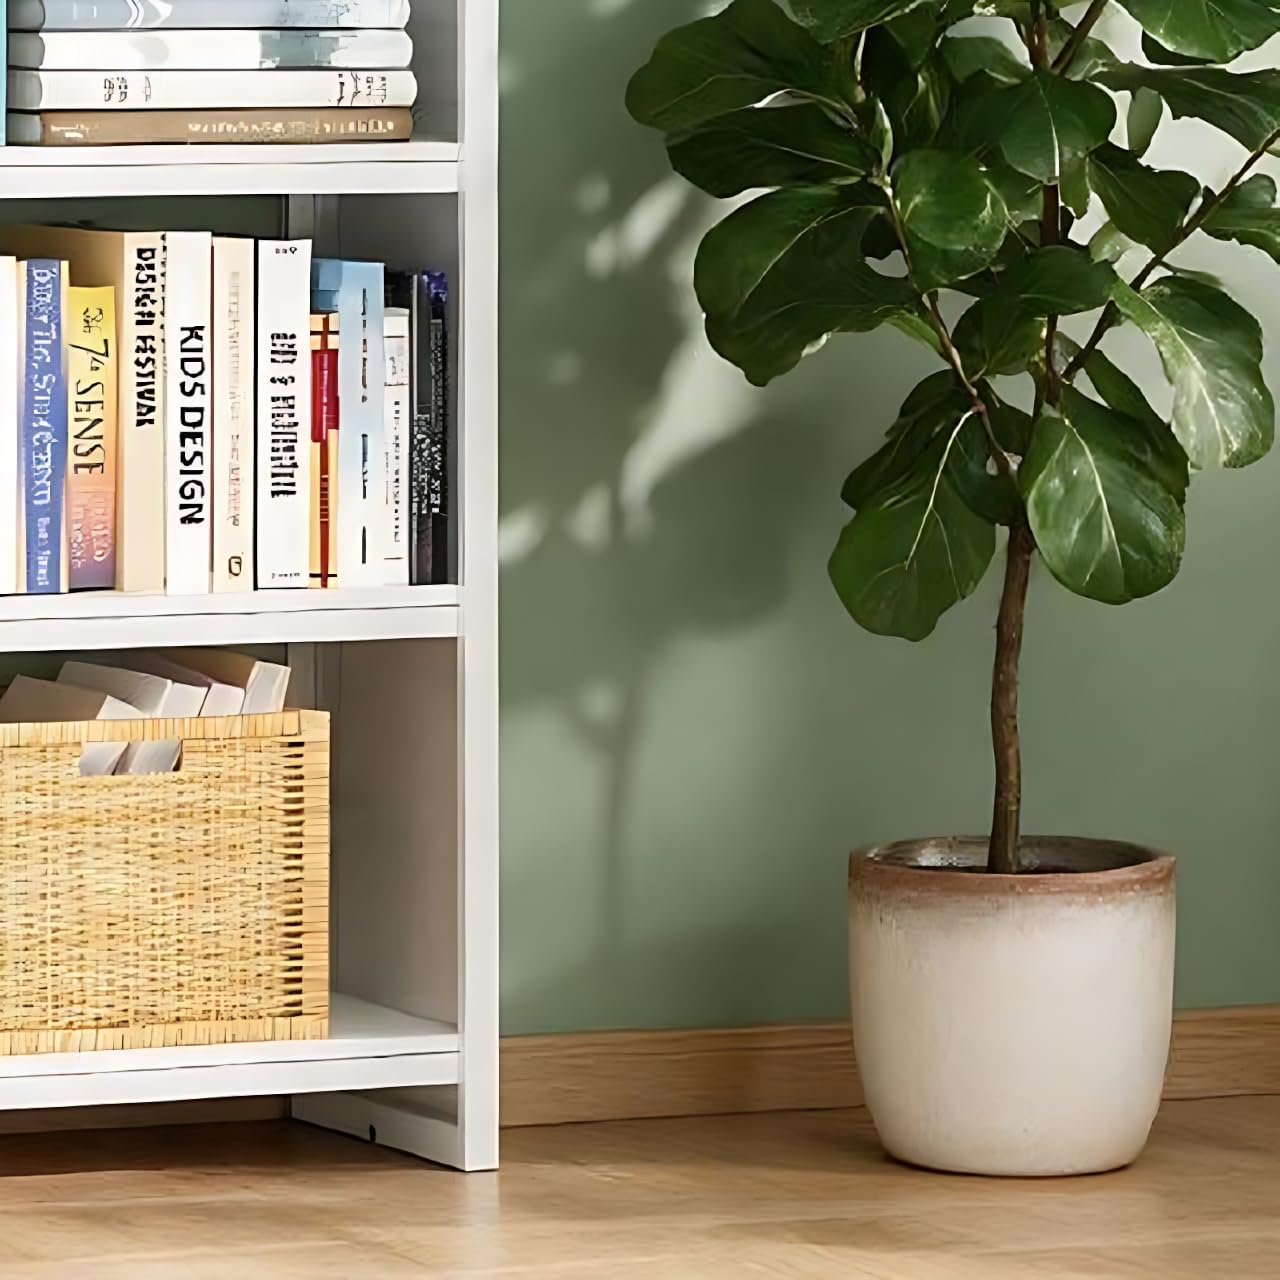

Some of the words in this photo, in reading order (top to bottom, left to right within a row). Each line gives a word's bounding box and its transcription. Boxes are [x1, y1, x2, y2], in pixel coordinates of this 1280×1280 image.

[179, 325, 206, 395] KIDS
[74, 379, 105, 475] SENSE
[179, 406, 205, 525] DESIGN
